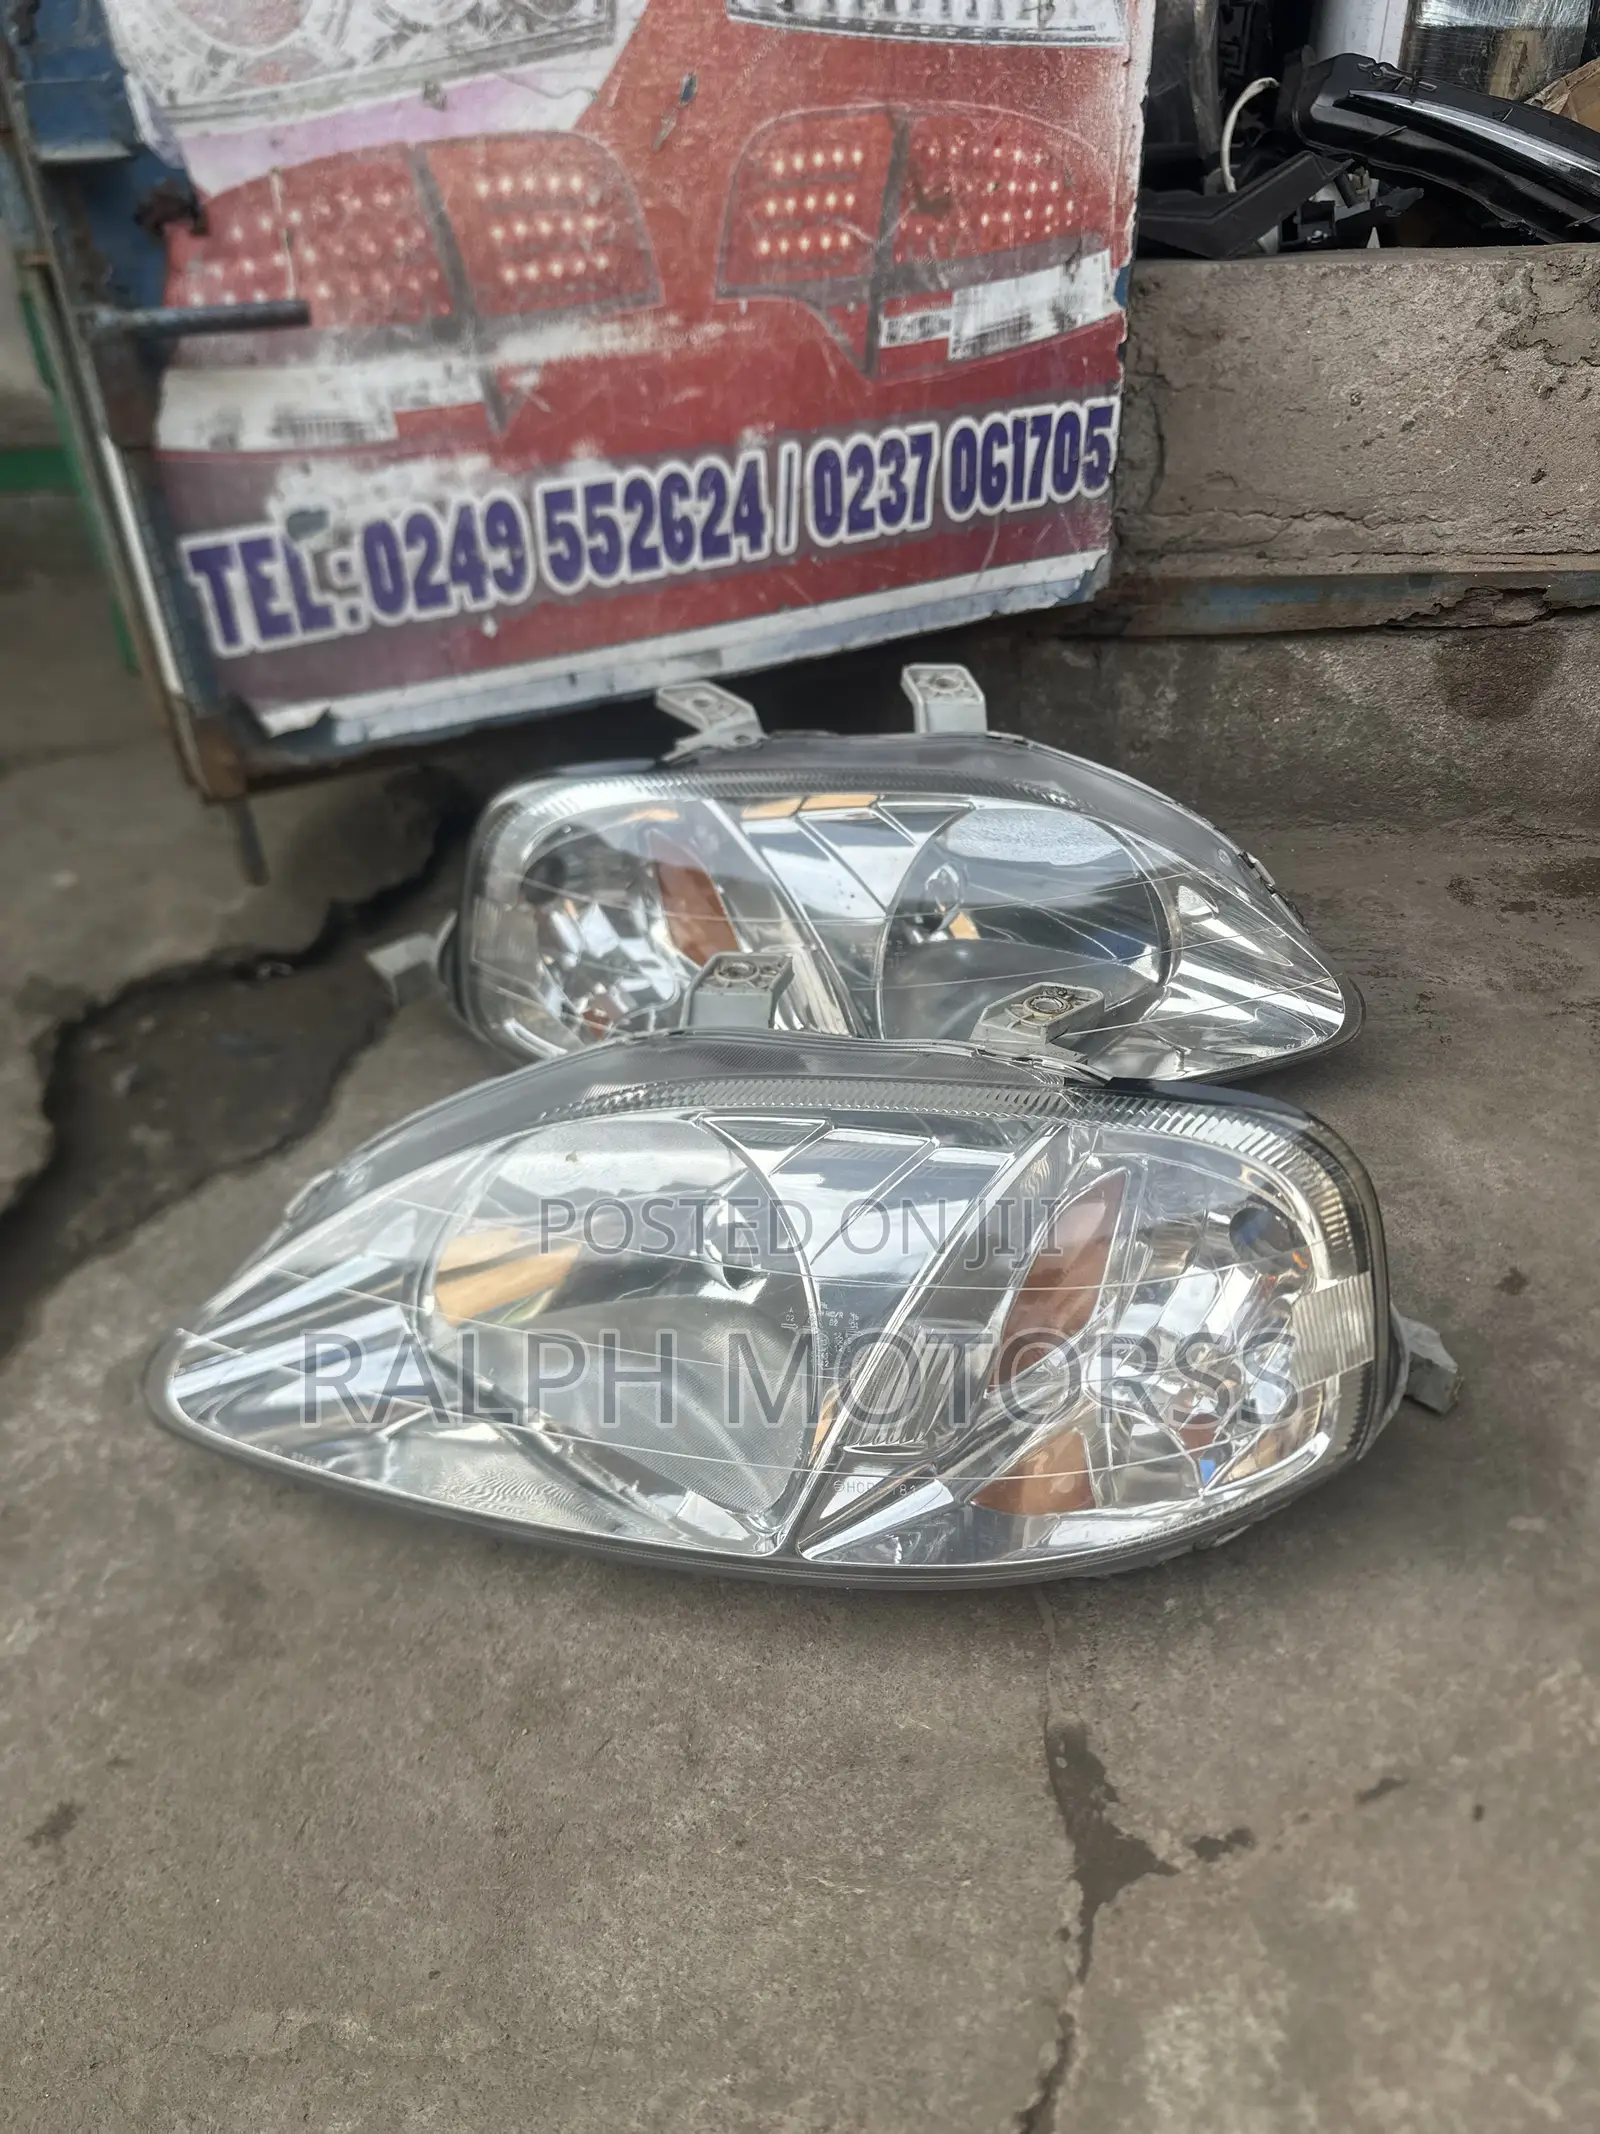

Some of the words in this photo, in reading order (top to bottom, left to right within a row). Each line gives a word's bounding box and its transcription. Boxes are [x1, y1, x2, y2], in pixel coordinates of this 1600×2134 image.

[535, 449, 771, 593] 552624
[809, 427, 938, 545] 0237
[946, 401, 1119, 519] 061705
